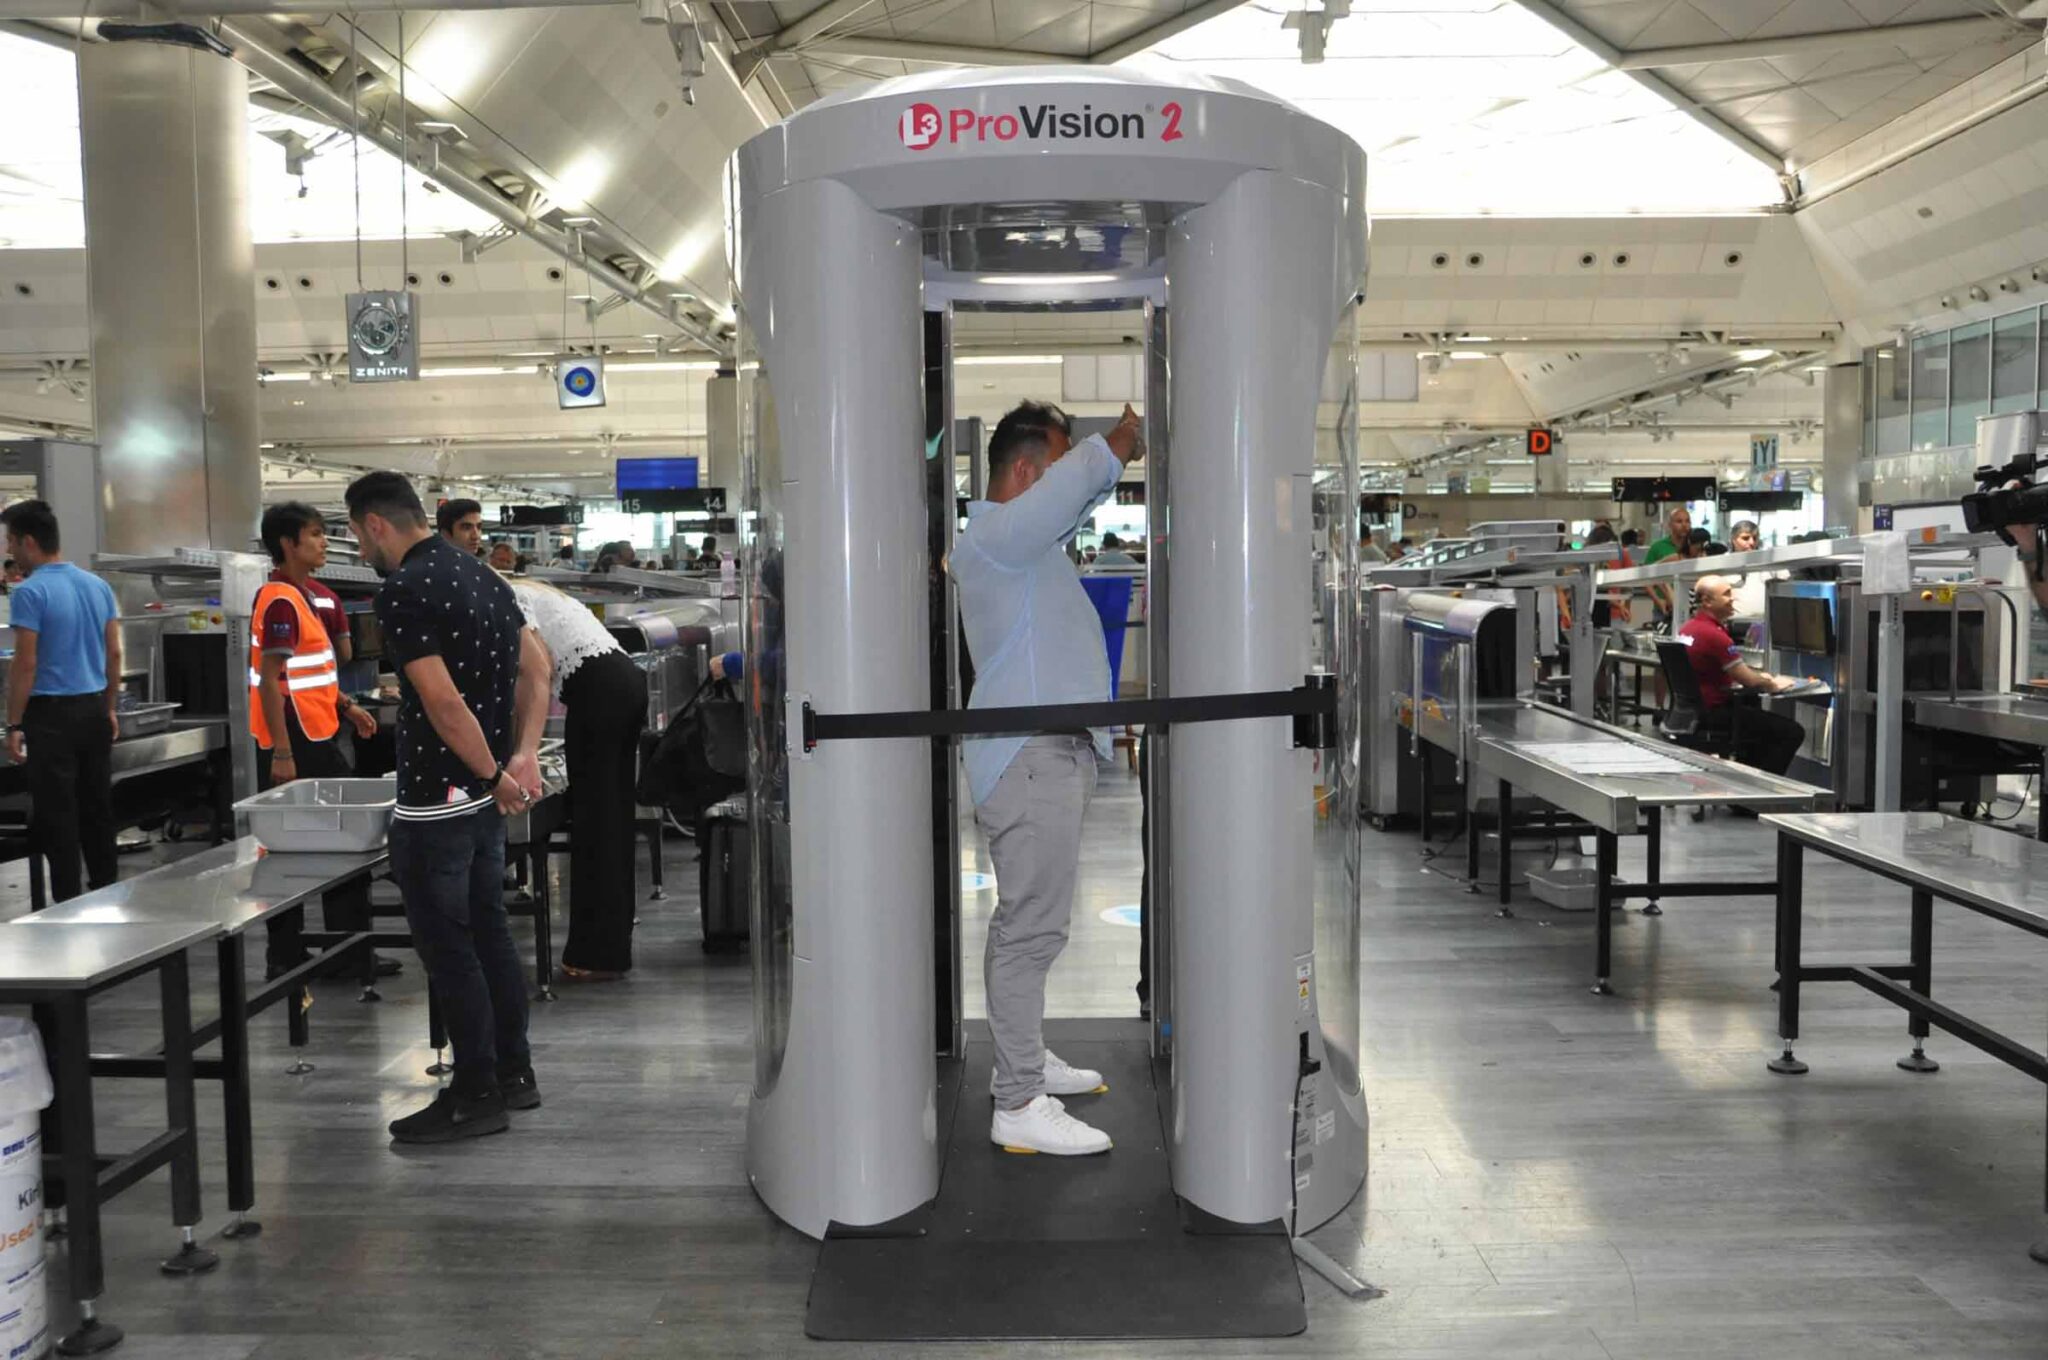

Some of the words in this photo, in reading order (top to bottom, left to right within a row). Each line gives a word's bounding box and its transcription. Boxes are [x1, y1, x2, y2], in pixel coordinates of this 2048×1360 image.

[1161, 102, 1183, 142] 2
[356, 367, 408, 377] ZENITH
[1531, 431, 1550, 452] D
[1119, 491, 1133, 504] 11
[1617, 487, 1625, 499] 7
[1705, 486, 1714, 498] 6
[623, 499, 641, 511] 15
[704, 497, 722, 510] 14
[1720, 499, 1728, 510] 5
[1403, 503, 1417, 519] D
[566, 512, 582, 523] 16
